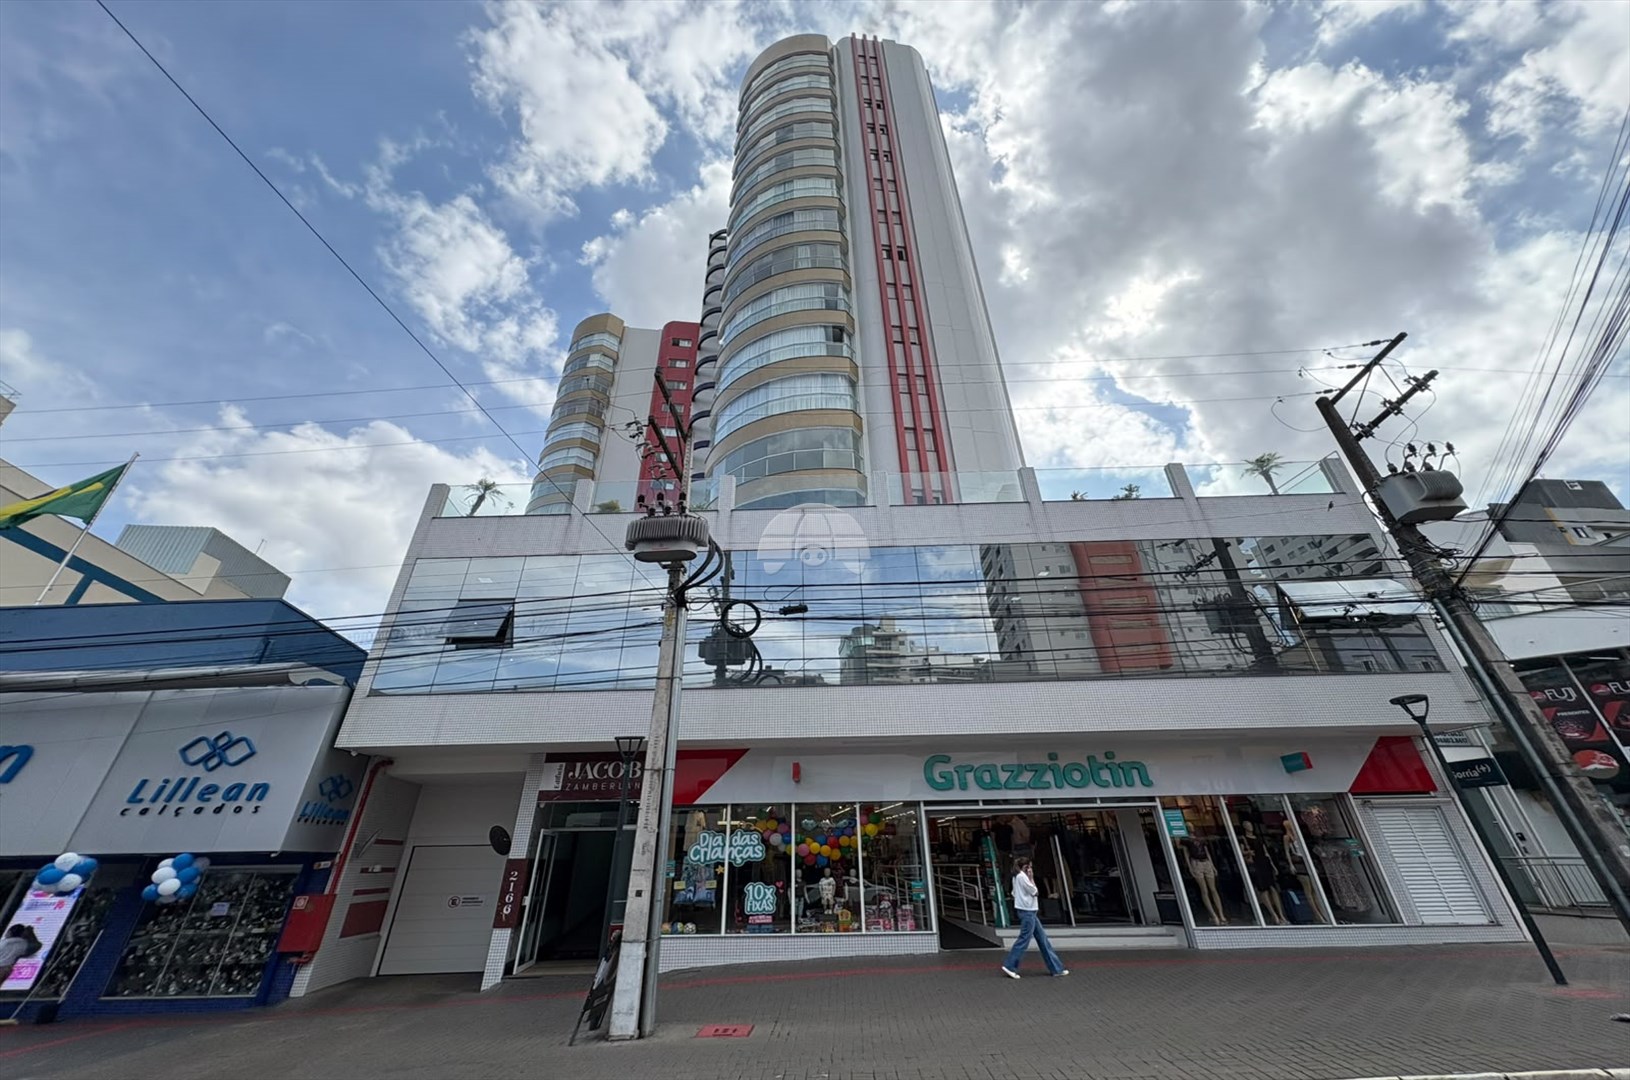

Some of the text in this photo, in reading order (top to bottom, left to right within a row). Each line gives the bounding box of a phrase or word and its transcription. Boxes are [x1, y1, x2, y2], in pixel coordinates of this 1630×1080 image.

[1545, 687, 1578, 702] FUJI
[1607, 680, 1630, 695] FU
[567, 760, 642, 780] JACOB
[923, 751, 1154, 791] Grazziotin
[126, 777, 270, 804] Lillean
[120, 804, 261, 818] calçados
[299, 801, 350, 821] Lillean
[700, 832, 758, 847] Dia das
[689, 845, 763, 864] Crianças
[502, 871, 518, 915] 2166
[746, 884, 774, 901] 10x
[746, 898, 774, 912] FIXAS
